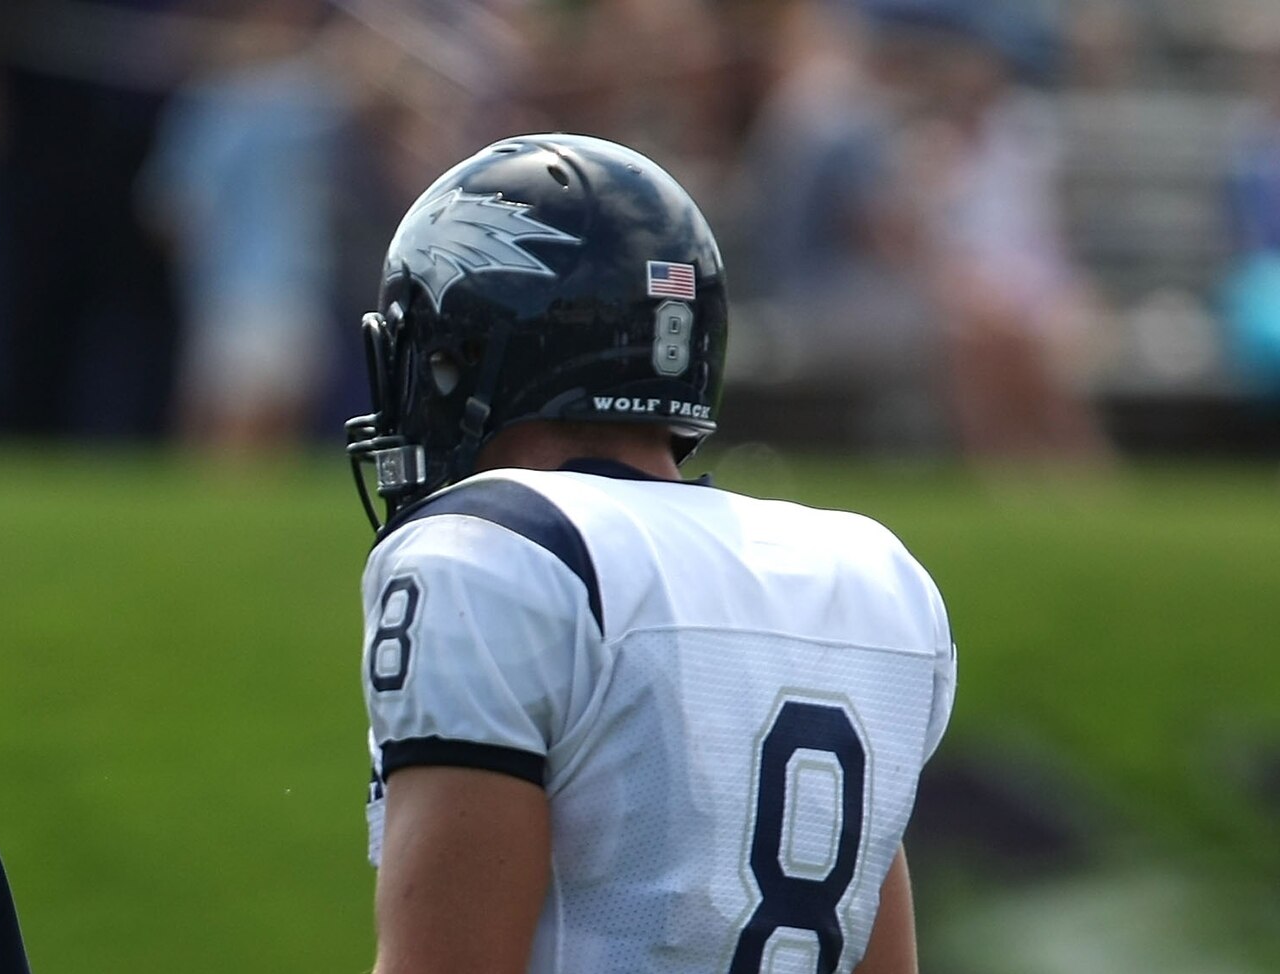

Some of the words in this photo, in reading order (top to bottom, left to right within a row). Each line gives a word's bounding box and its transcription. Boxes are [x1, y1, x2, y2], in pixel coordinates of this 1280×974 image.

[653, 301, 693, 376] 8
[593, 397, 661, 411] WOLF
[670, 401, 711, 419] PACK
[368, 570, 423, 694] 8
